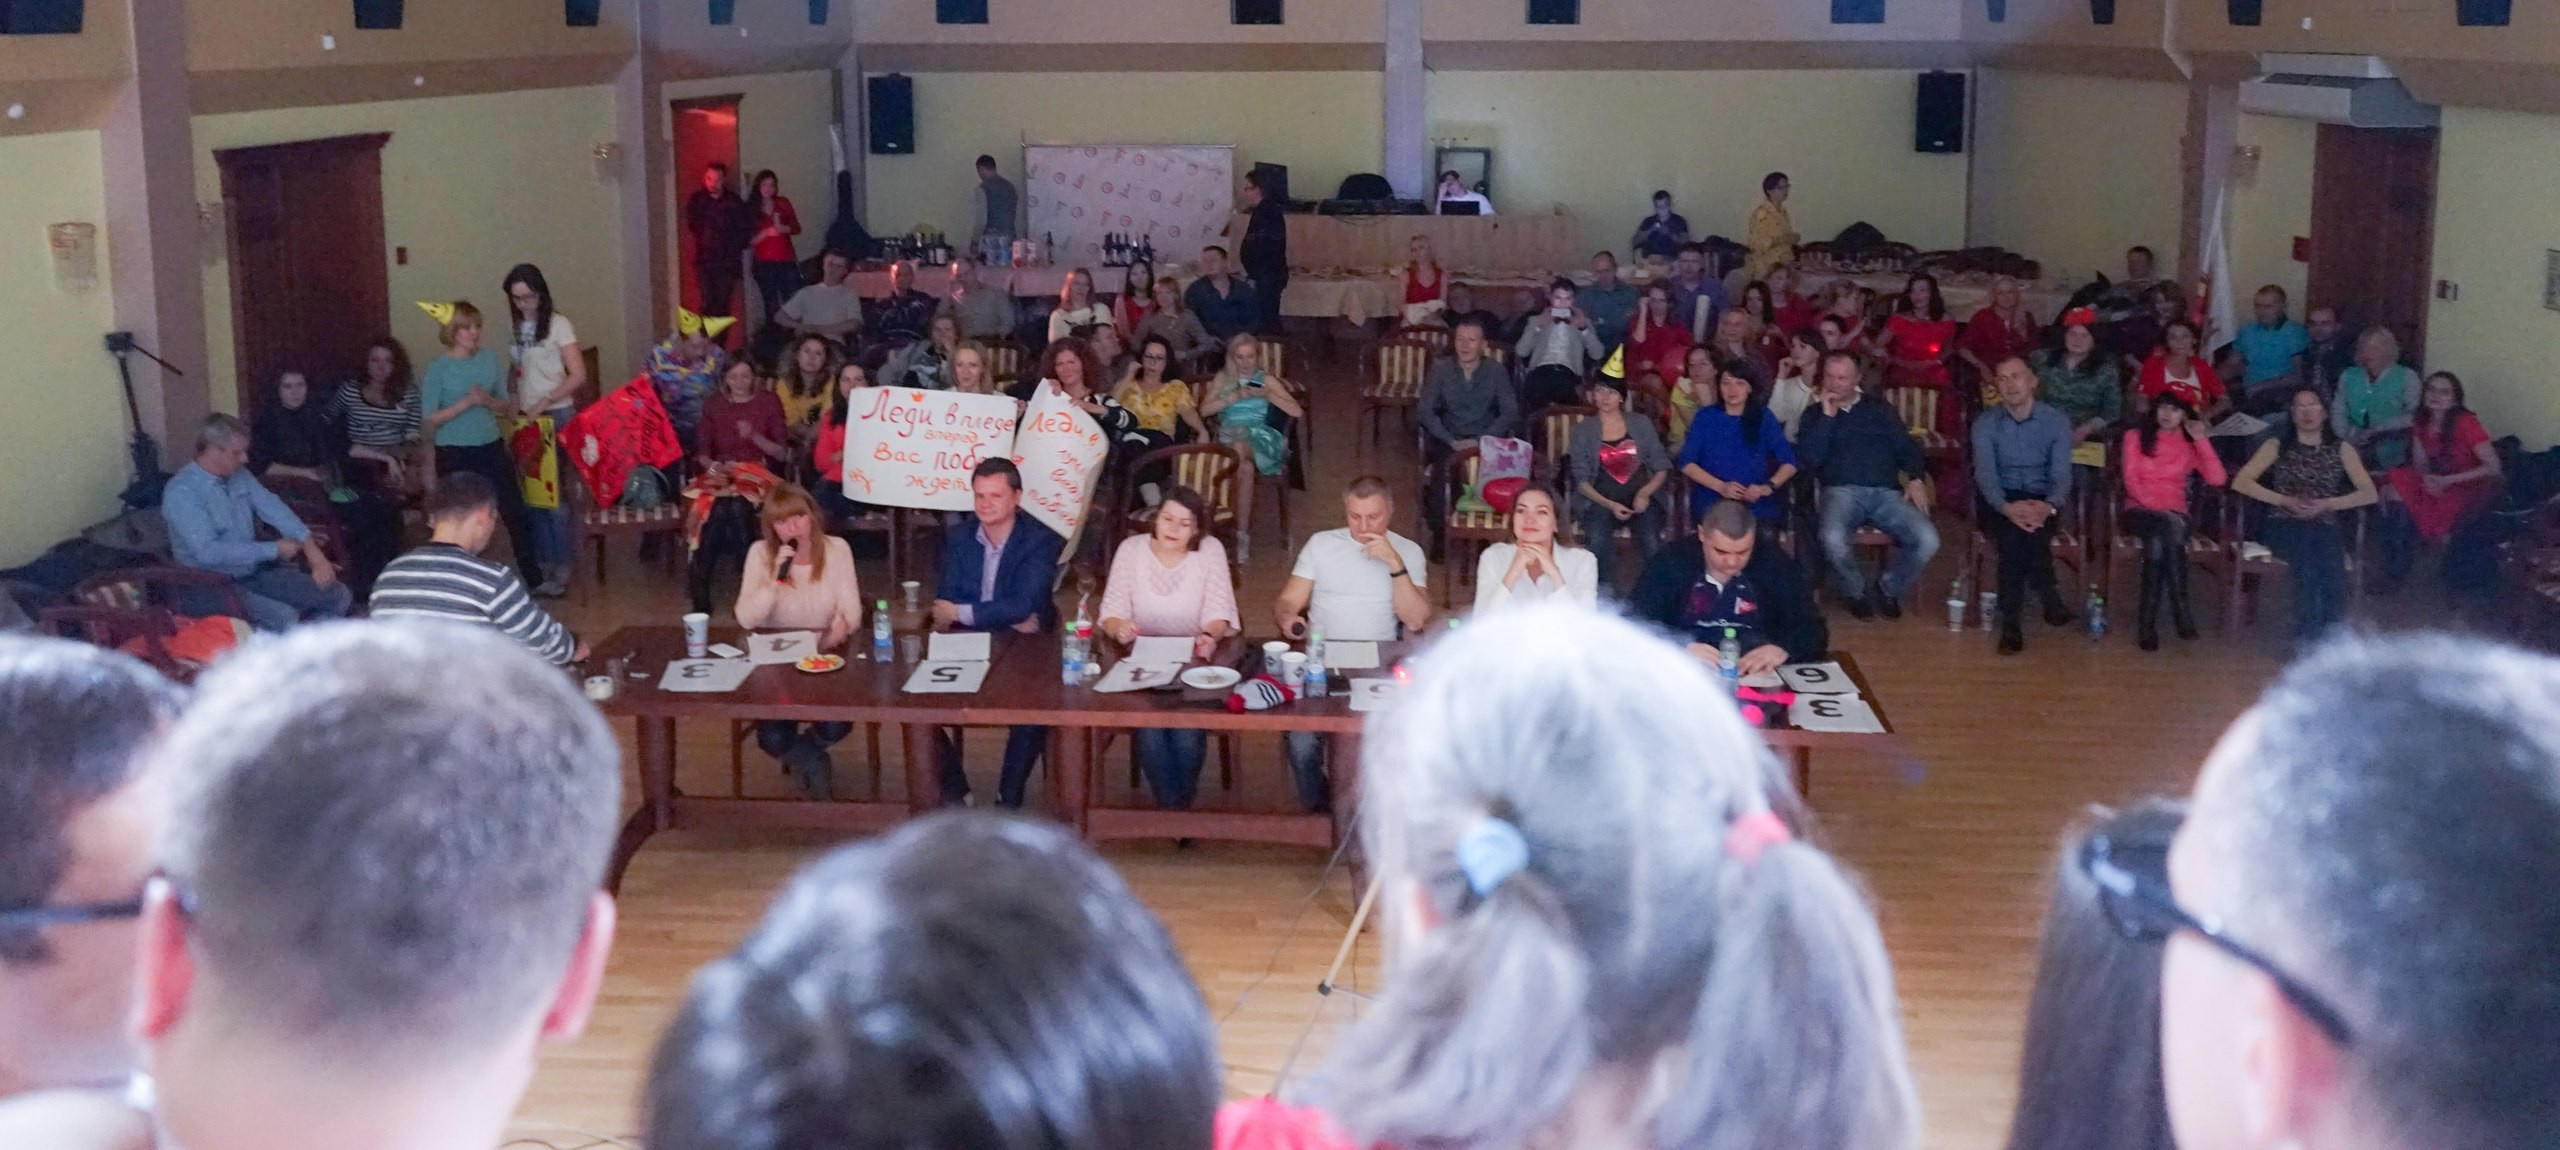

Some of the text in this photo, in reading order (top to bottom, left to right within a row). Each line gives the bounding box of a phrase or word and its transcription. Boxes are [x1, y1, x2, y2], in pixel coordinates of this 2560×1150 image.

[861, 389, 934, 438] Леди
[873, 441, 923, 464] Вас
[769, 637, 802, 652] 4
[681, 662, 715, 679] 3
[930, 666, 964, 683] 5
[1128, 665, 1161, 683] 4
[1808, 699, 1843, 718] 3
